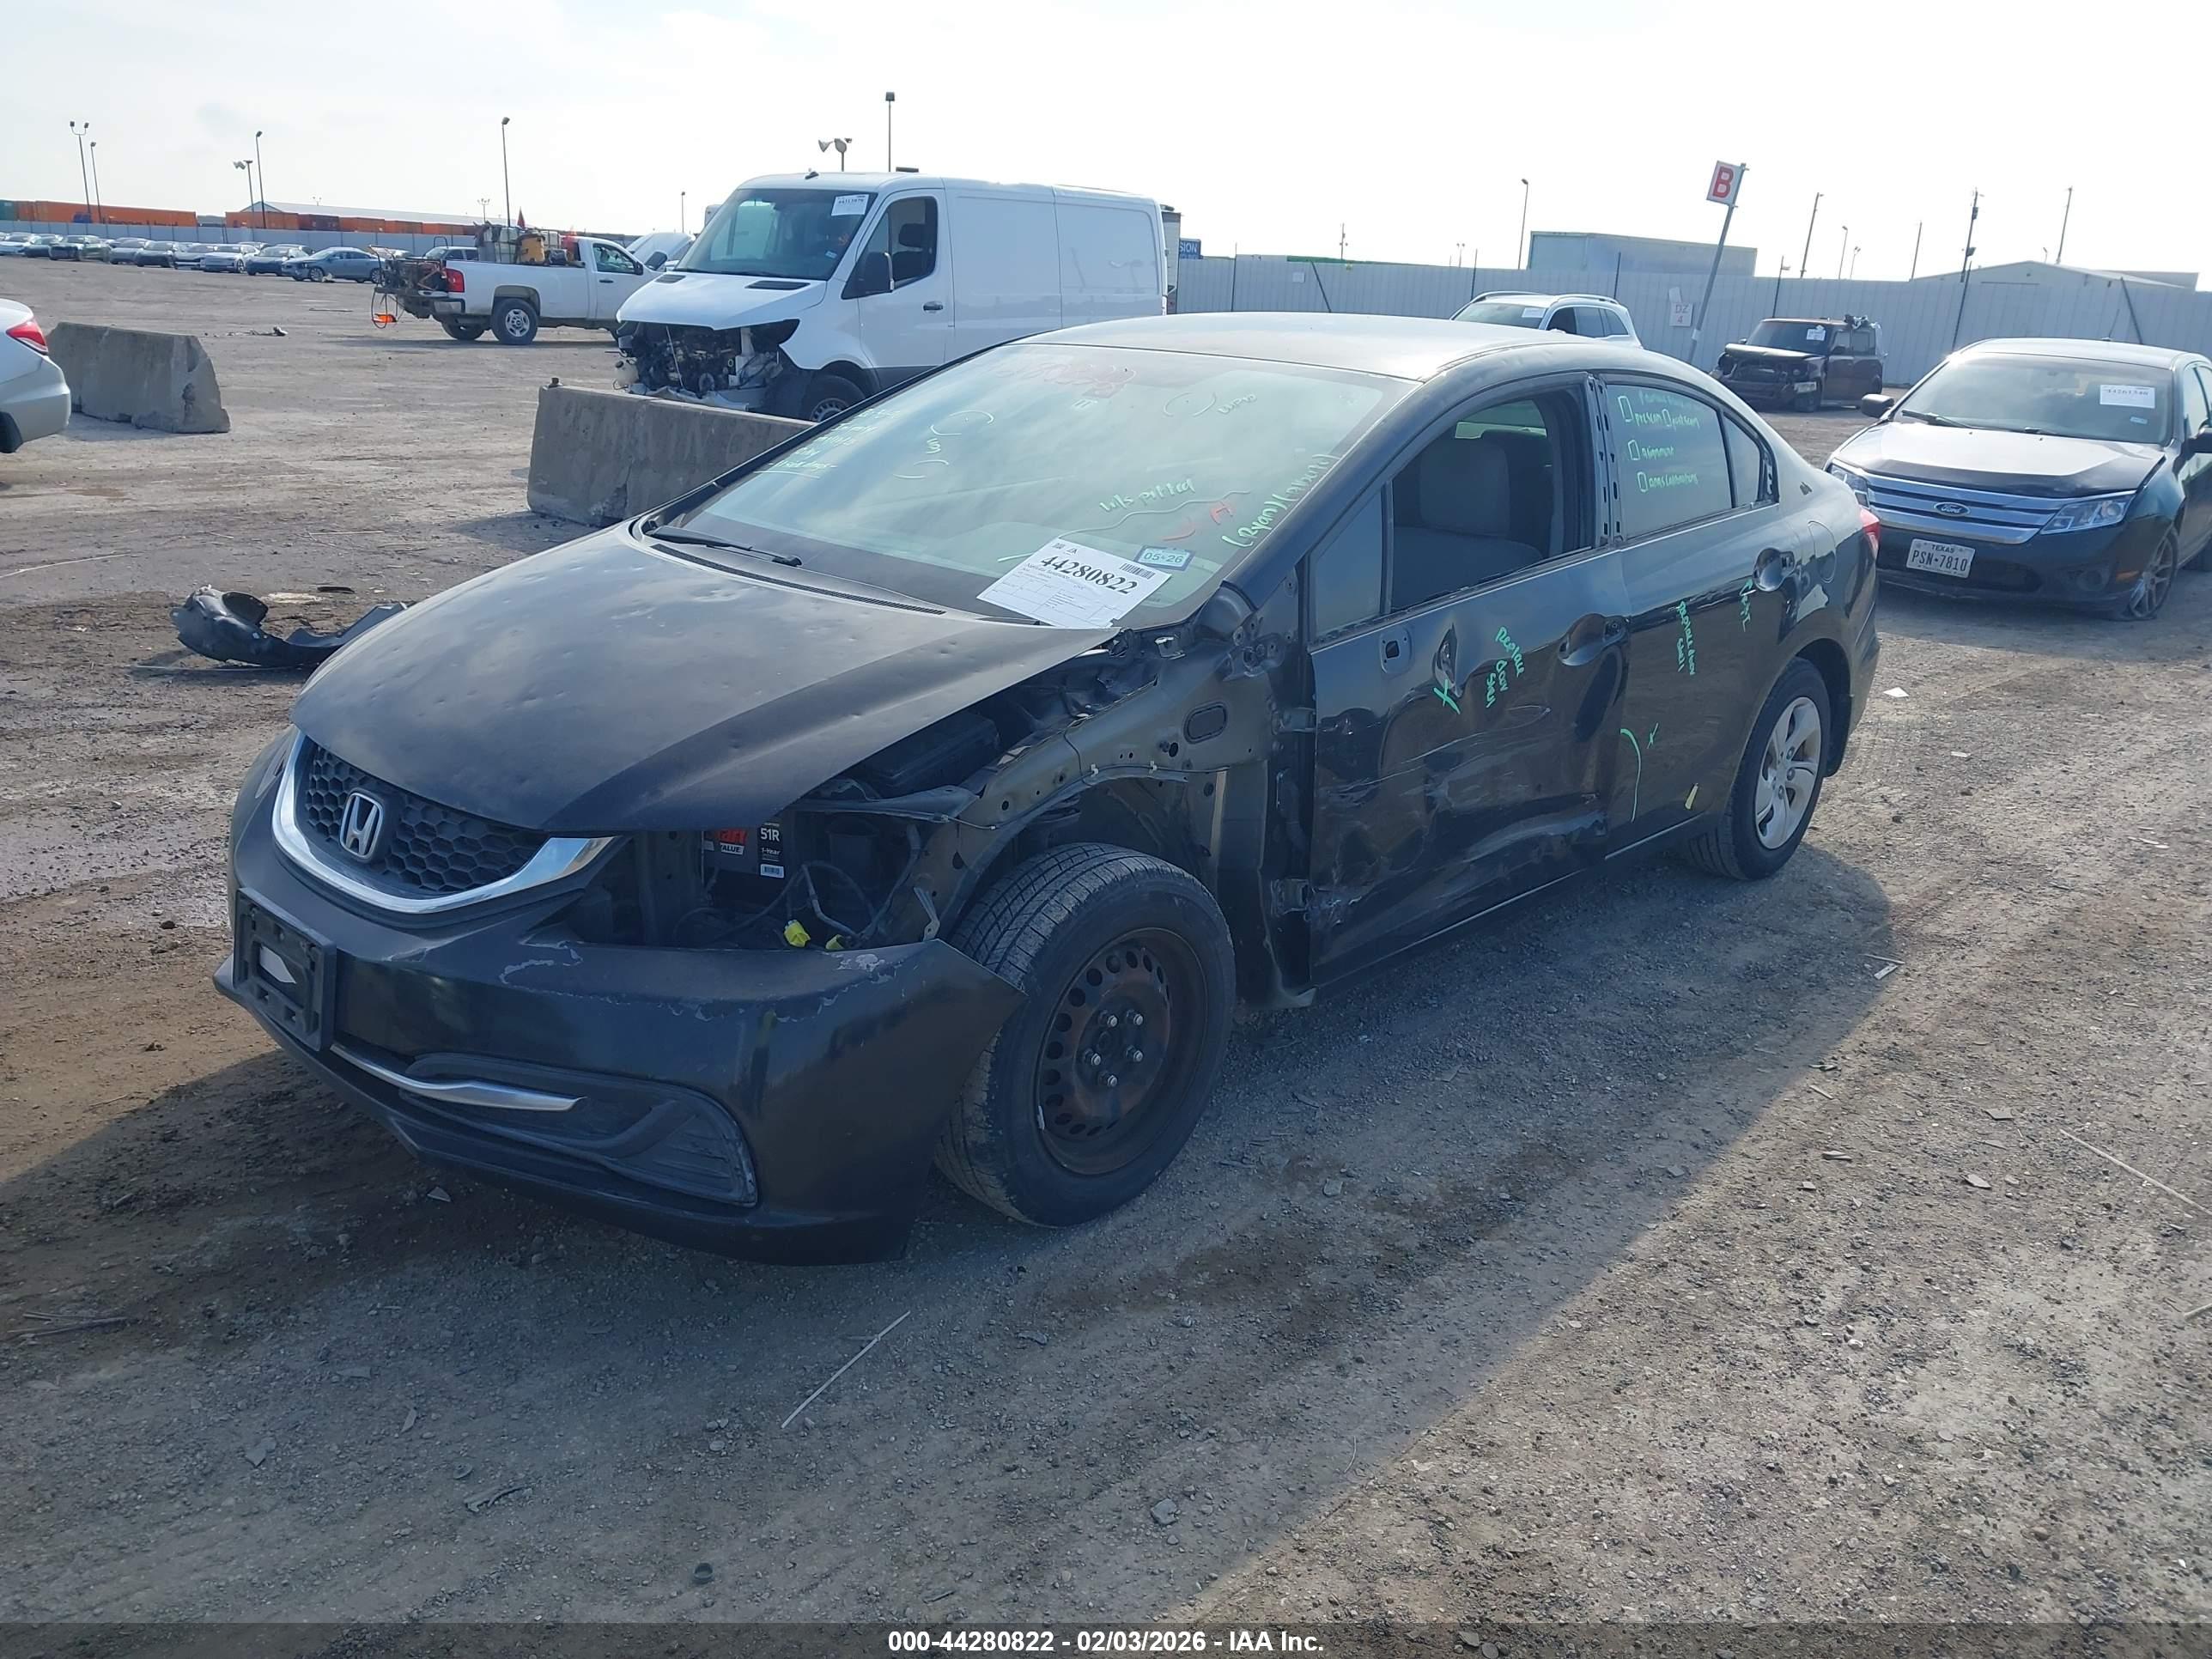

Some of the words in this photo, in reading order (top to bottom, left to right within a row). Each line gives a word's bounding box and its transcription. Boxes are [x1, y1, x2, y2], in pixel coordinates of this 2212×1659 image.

[1712, 166, 1735, 198] B
[1677, 315, 1684, 325] 4
[1940, 503, 1961, 514] Ford
[1931, 544, 1955, 554] TEXAS
[1041, 556, 1139, 595] 44280822
[760, 827, 780, 842] 51R
